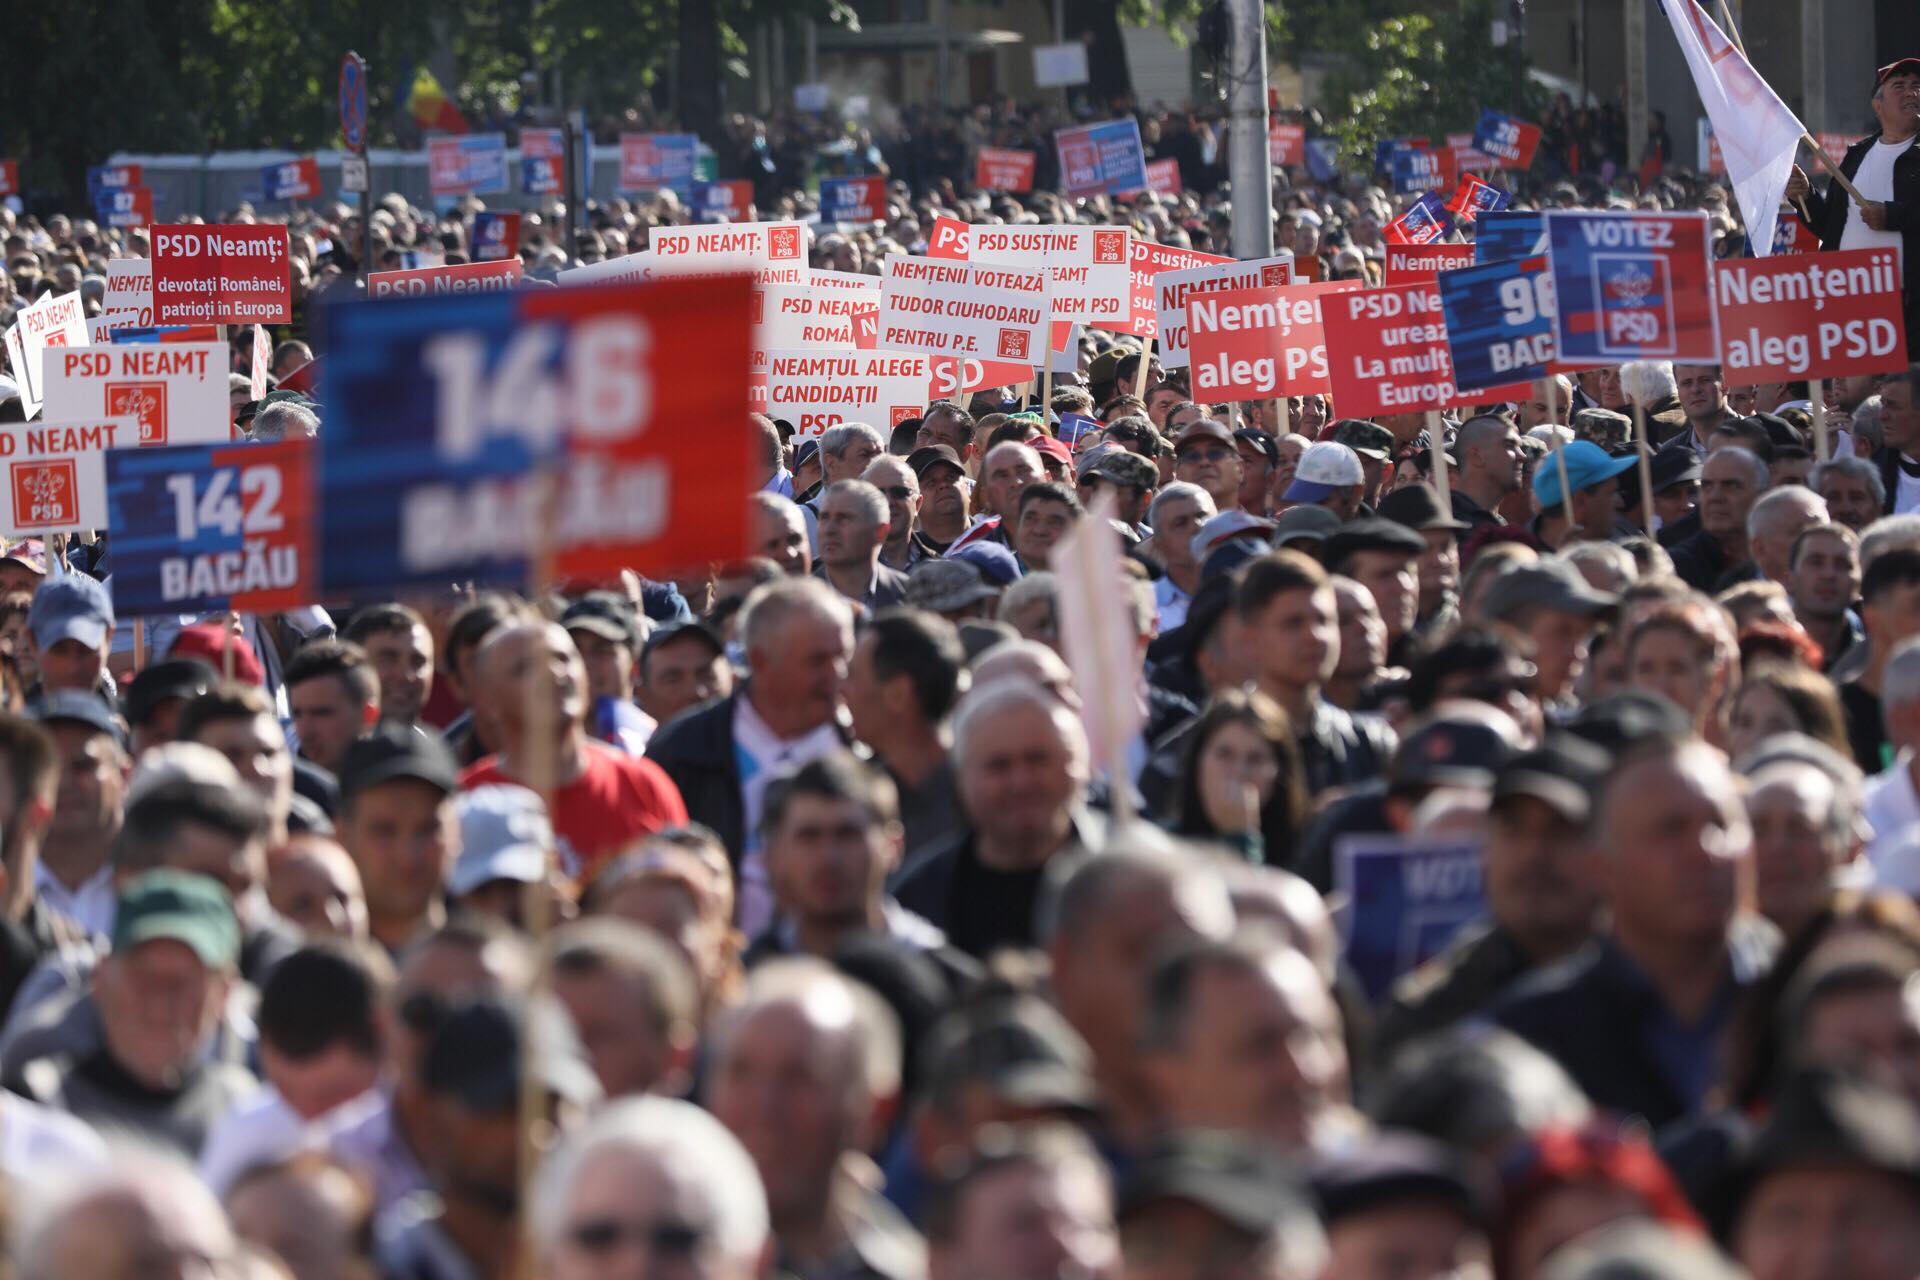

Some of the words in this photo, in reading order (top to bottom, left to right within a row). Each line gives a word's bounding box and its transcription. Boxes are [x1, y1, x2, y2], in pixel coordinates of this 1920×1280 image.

[657, 236, 690, 256] PSD
[697, 233, 761, 257] NEAMȚ:
[937, 226, 969, 255] PS
[978, 234, 1008, 251] PSD
[1011, 234, 1079, 256] SUSȚINE
[1580, 220, 1675, 248] VOTEZ
[157, 234, 200, 257] PSD
[207, 235, 283, 263] Neamț:
[777, 248, 793, 257] PSD
[1102, 252, 1118, 261] PSD
[107, 275, 152, 296] NEMȚE
[158, 277, 217, 296] devotați
[220, 276, 285, 293] Românei,
[892, 261, 969, 285] NEMȚENII
[974, 269, 1044, 292] VOTEAZĂ
[1052, 267, 1089, 285] EAMȚ
[1719, 254, 1895, 311] Nemțenii
[162, 302, 214, 320] patrioți
[218, 301, 231, 316] în
[235, 302, 283, 319] Europa
[782, 298, 813, 314] PSD
[890, 294, 944, 315] TUDOR
[946, 301, 1041, 325] CIUHODARU
[1052, 298, 1085, 313] NEM
[1091, 298, 1119, 313] PSD
[1350, 292, 1402, 321] PSD
[1407, 290, 1444, 315] Ne
[1134, 317, 1156, 335] PS
[1165, 326, 1188, 351] VO
[1382, 323, 1448, 347] ureaz
[1611, 312, 1659, 342] PSD
[885, 327, 948, 348] PENTRU
[952, 334, 979, 352] P.E.
[1005, 348, 1021, 356] PSD
[1727, 327, 1811, 373] aleg
[1819, 318, 1897, 360] PSD
[1353, 355, 1386, 380] La
[1390, 347, 1449, 377] mulț
[1490, 333, 1556, 373] BAC
[64, 353, 111, 378] PSD
[122, 350, 209, 382] NEAMȚ
[772, 358, 859, 381] NEAMȚUL
[866, 359, 924, 377] ALEGE
[1198, 352, 1276, 392] aleg
[1285, 345, 1329, 380] PS
[420, 311, 654, 464] 146
[772, 385, 879, 408] CANDIDAȚII
[31, 503, 63, 521] PSD
[166, 464, 284, 541] 142
[160, 539, 299, 601] BACĂU
